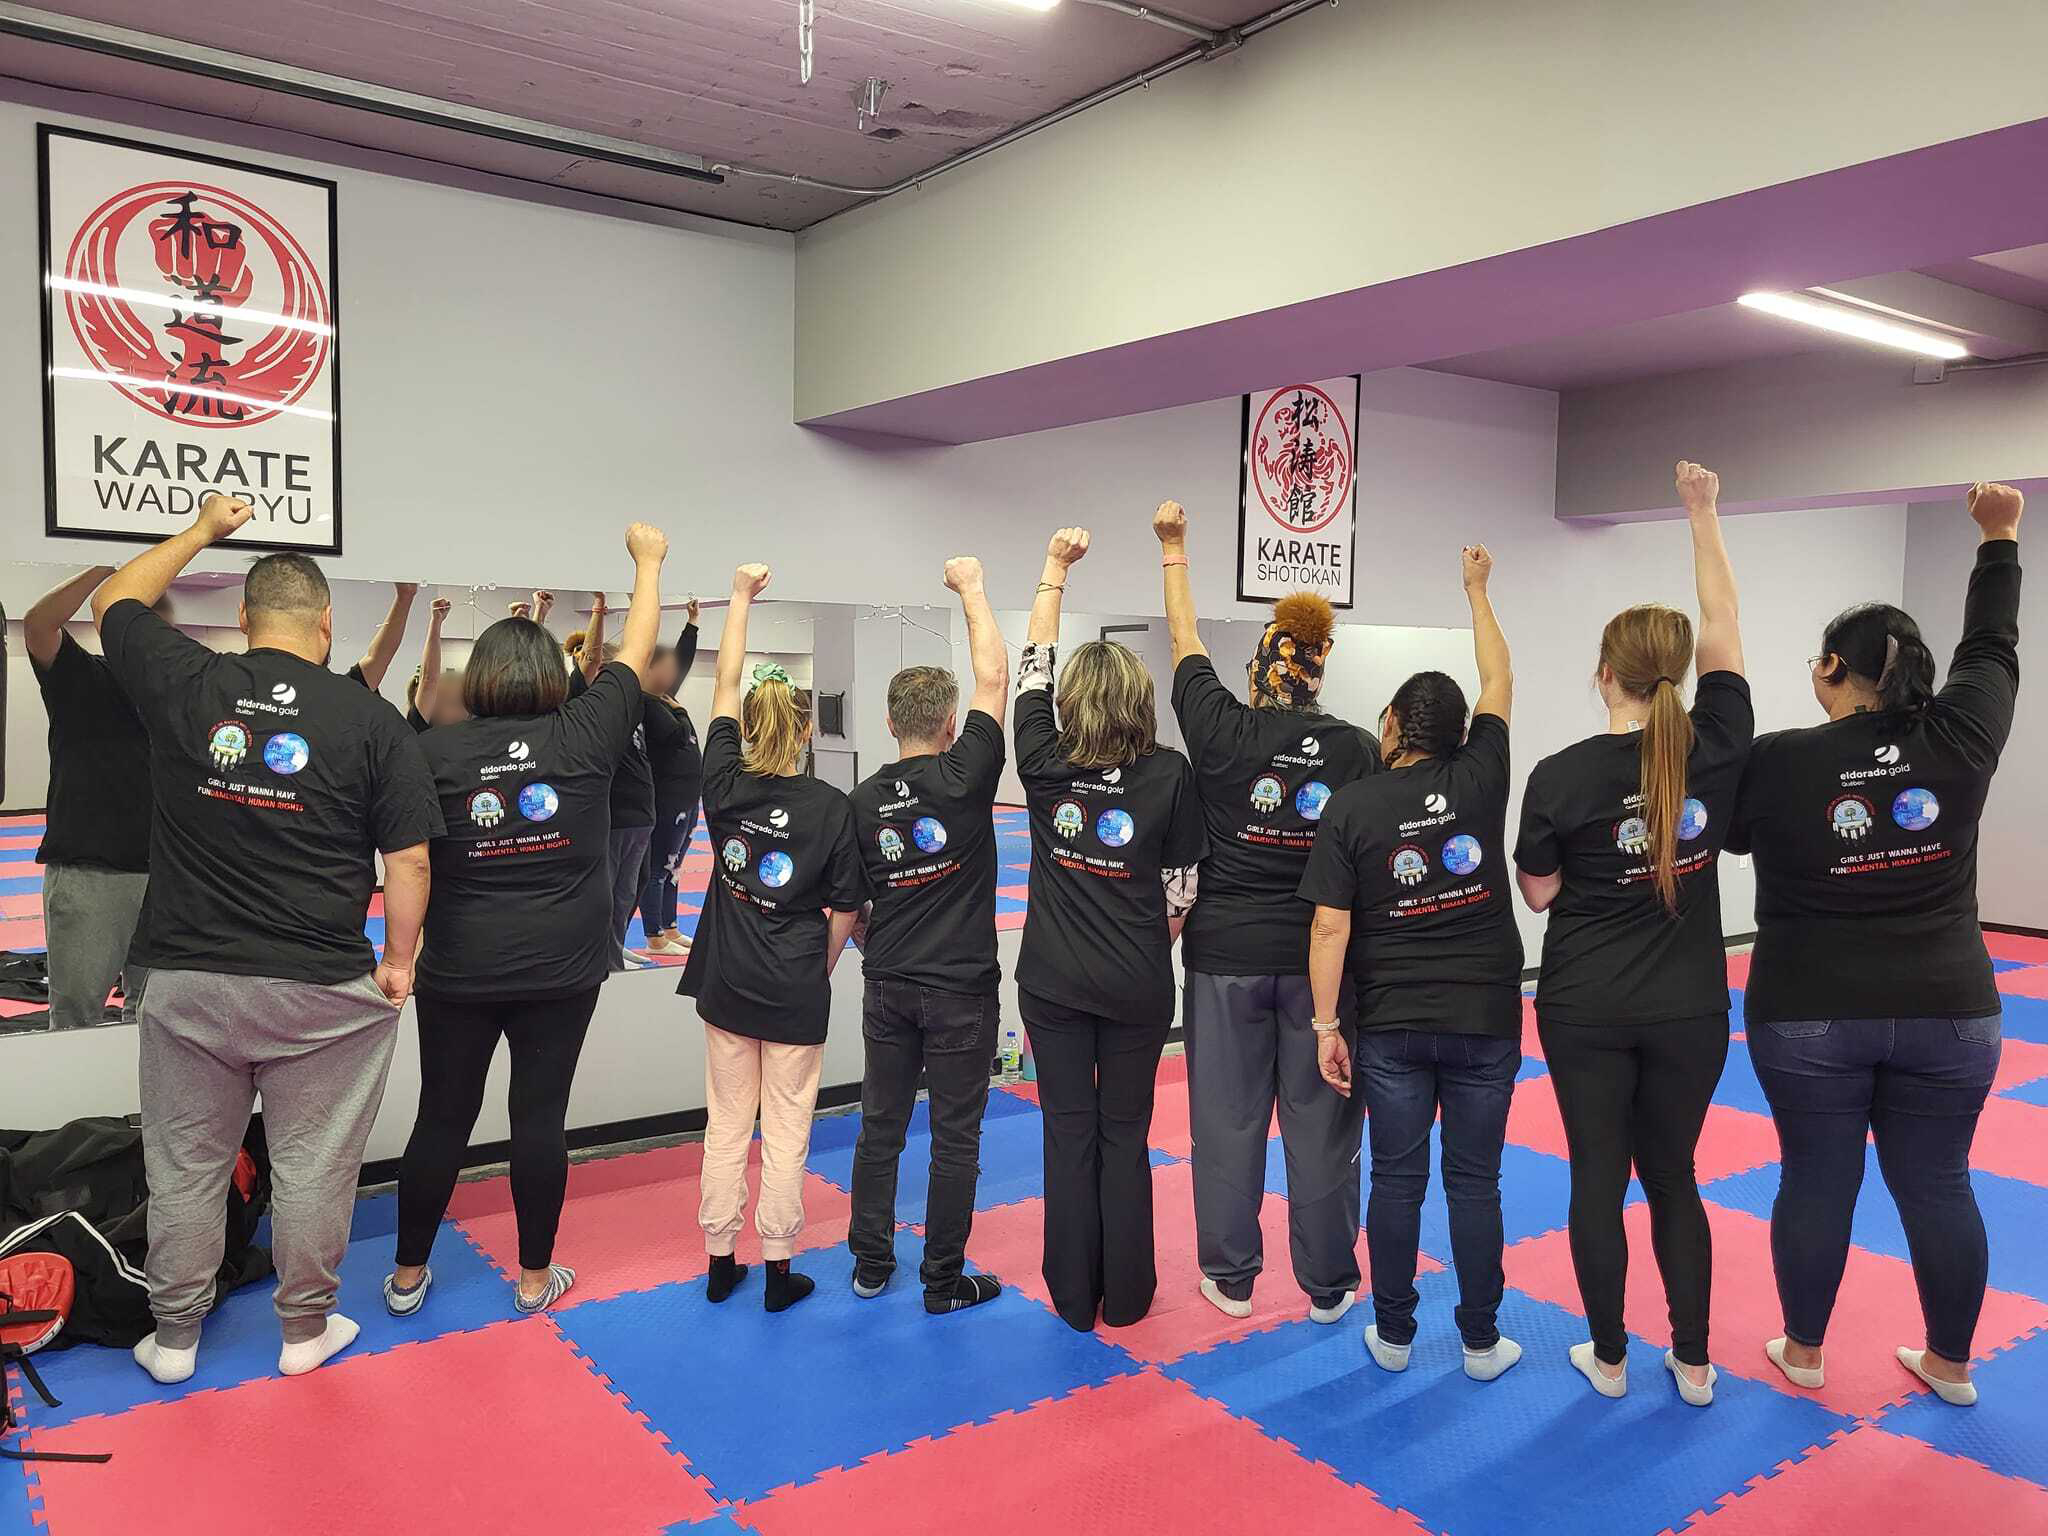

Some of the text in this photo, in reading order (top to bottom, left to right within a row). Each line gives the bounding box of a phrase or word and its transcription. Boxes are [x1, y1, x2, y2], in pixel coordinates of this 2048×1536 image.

[94, 434, 311, 492] KARATE
[1258, 537, 1341, 567] KARATE
[1257, 563, 1341, 586] SHOTOKAN
[237, 699, 298, 716] eldorado gold
[480, 761, 536, 774] eldorado gold
[1273, 754, 1323, 767] eldorado gold
[1840, 763, 1910, 780] eldorado gold
[208, 778, 296, 800] GIRLS JUST WANNA HAVE
[1072, 781, 1124, 794] eldorado gold
[198, 786, 304, 812] FUNDAMENTAL HUMAN RIGHTS
[879, 797, 919, 812] eldorado gold
[741, 820, 789, 839] eldorado gold
[1247, 825, 1264, 833] GIRLS
[1266, 828, 1280, 836] JUST
[1399, 812, 1456, 831] eldorado gold
[499, 838, 514, 846] JUST
[516, 835, 541, 844] WANNA
[543, 832, 560, 840] HAVE
[1237, 832, 1280, 845] FUNDAMENTAL
[1282, 839, 1305, 847] HUMAN
[469, 839, 570, 858] FUNDAMENTAL HUMAN RIGHTS
[1693, 849, 1708, 860] HAVE
[1840, 843, 1941, 864] GIRLS JUST WANNA HAVE
[1053, 848, 1125, 869] GIRLS JUST WANNA HAVE
[1830, 850, 1952, 875] FUNDAMENTAL HUMAN RIGHTS
[917, 865, 937, 875] WANNA
[1088, 867, 1108, 876] HUMAN
[1109, 870, 1131, 879] RIGHTS
[760, 899, 777, 909] HAVE
[1390, 890, 1491, 918] FUNDAMENTAL HUMAN RIGHTS
[1398, 884, 1482, 907] GIRLS JUST WANNA HAVE
